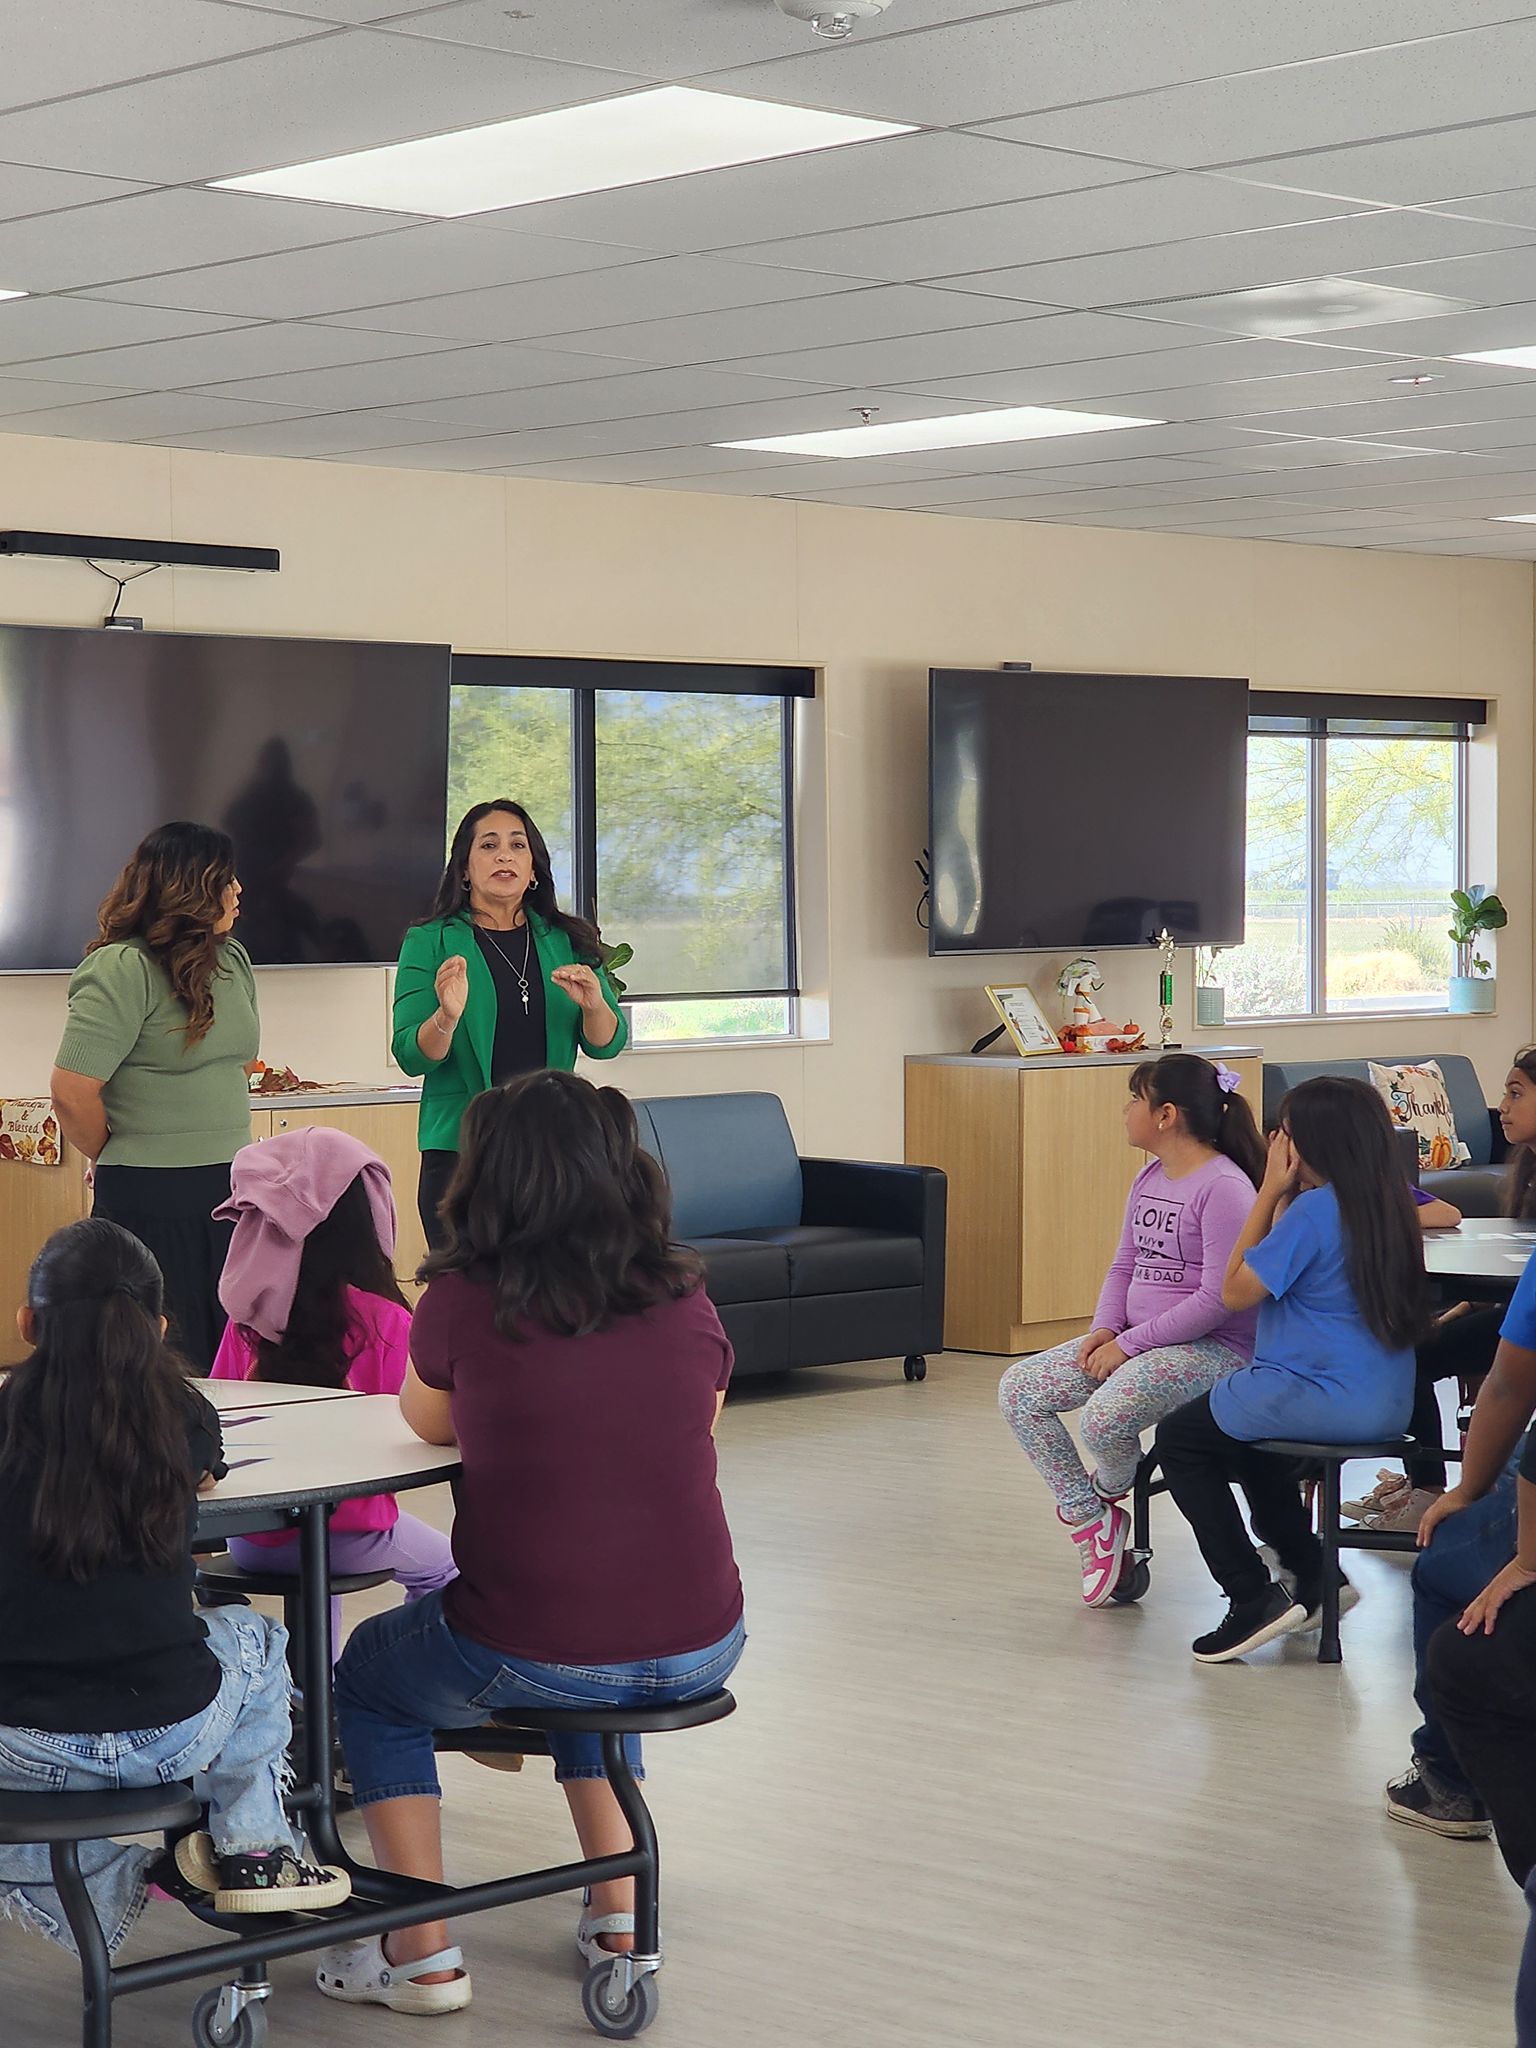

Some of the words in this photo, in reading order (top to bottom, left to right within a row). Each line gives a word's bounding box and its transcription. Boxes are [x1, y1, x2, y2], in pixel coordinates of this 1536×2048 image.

[8, 1120, 41, 1134] Blessed
[1134, 1205, 1177, 1233] LOVE
[1142, 1236, 1158, 1247] MY
[1153, 1270, 1184, 1283] DAD
